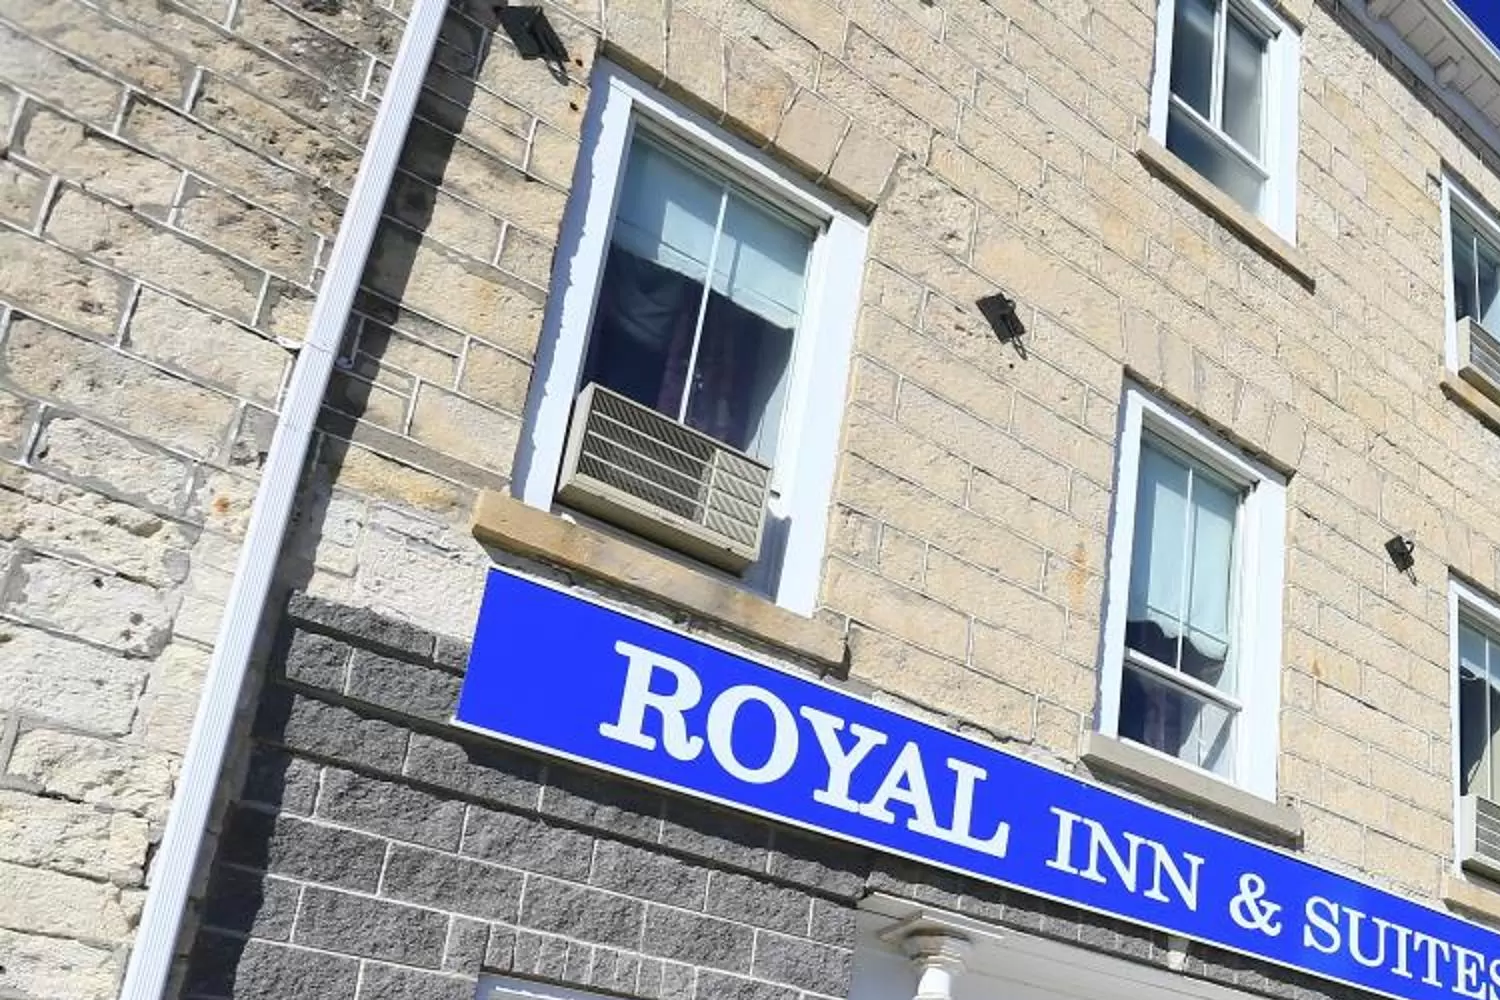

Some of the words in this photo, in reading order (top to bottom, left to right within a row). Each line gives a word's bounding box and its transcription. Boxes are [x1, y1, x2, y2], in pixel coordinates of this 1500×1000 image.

[599, 639, 1010, 860] ROYAL
[1045, 806, 1205, 912] INN
[1229, 873, 1282, 937] &
